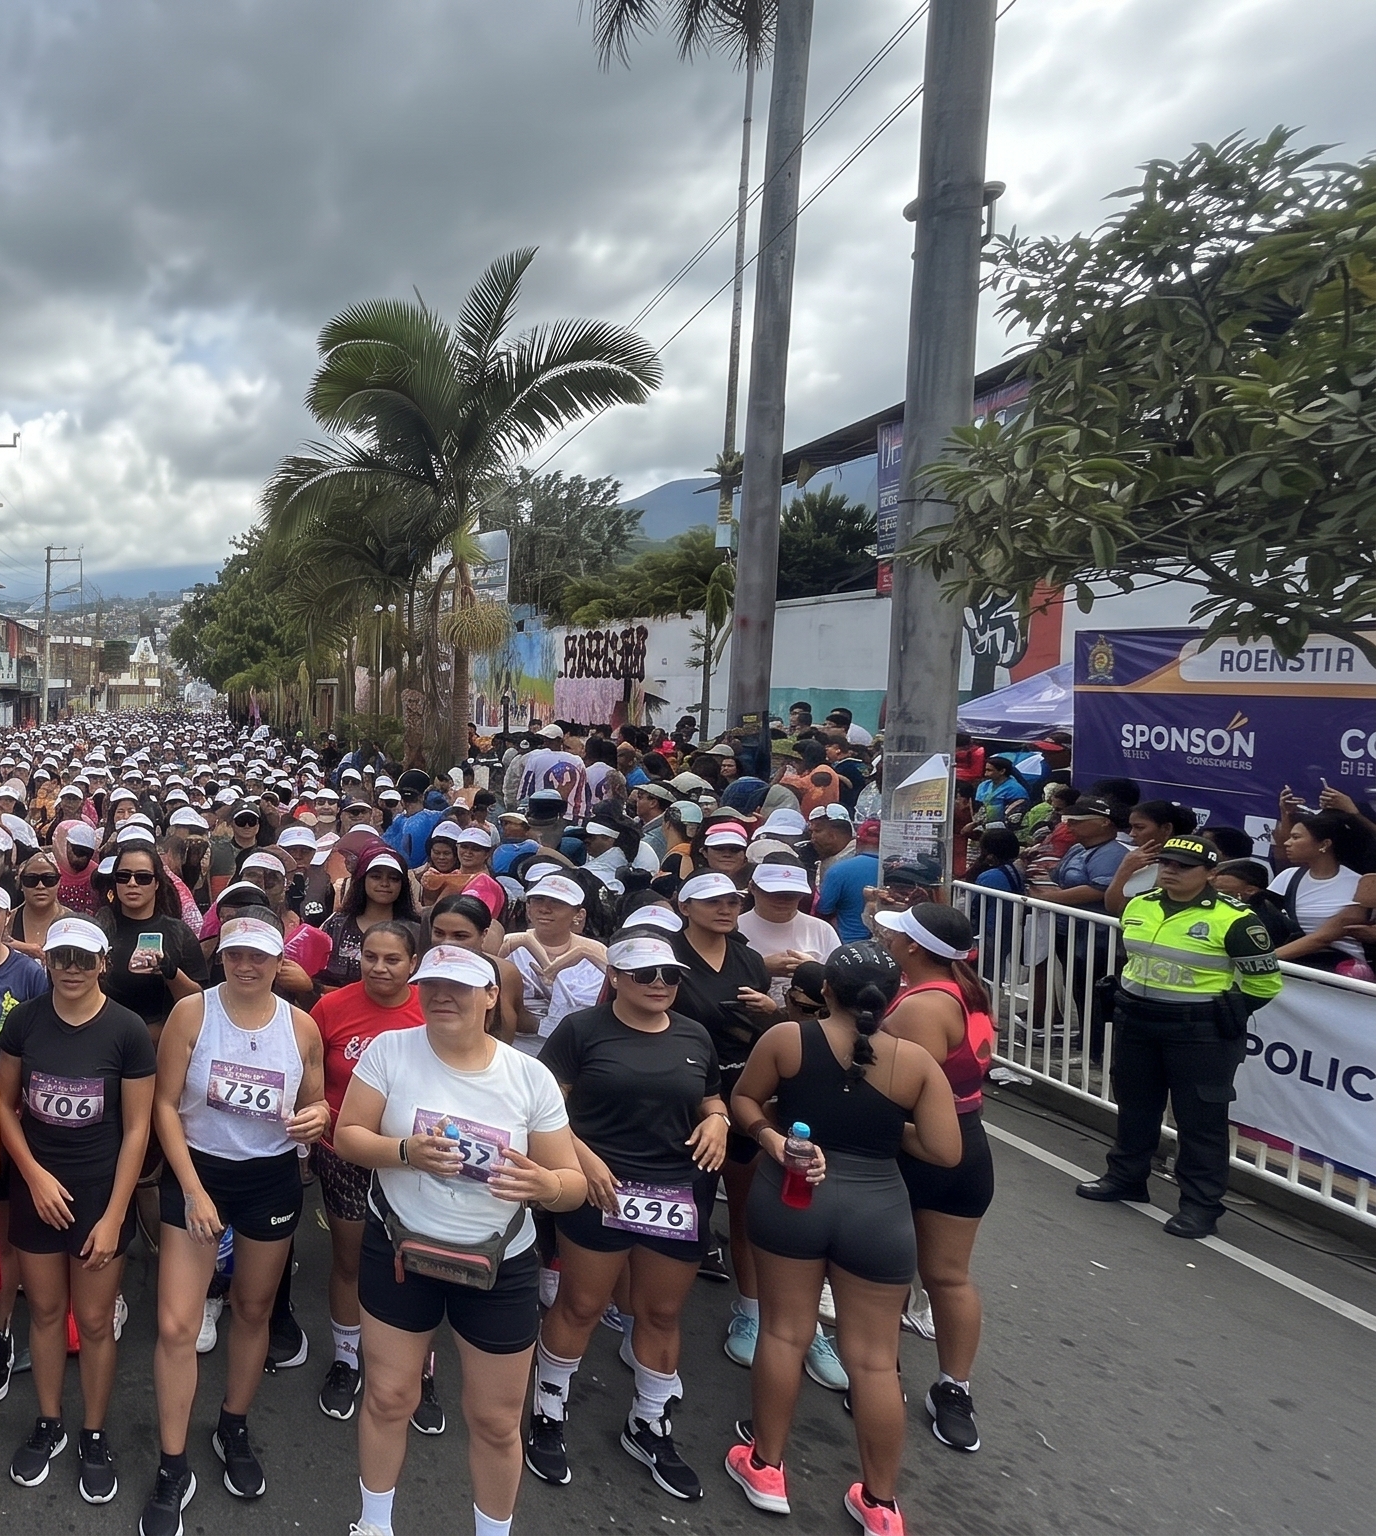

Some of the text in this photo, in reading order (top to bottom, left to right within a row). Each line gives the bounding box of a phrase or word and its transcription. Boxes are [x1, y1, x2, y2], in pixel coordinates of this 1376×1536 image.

[40, 1092, 92, 1118] 706
[224, 1080, 271, 1110] 736
[623, 1197, 684, 1227] 696
